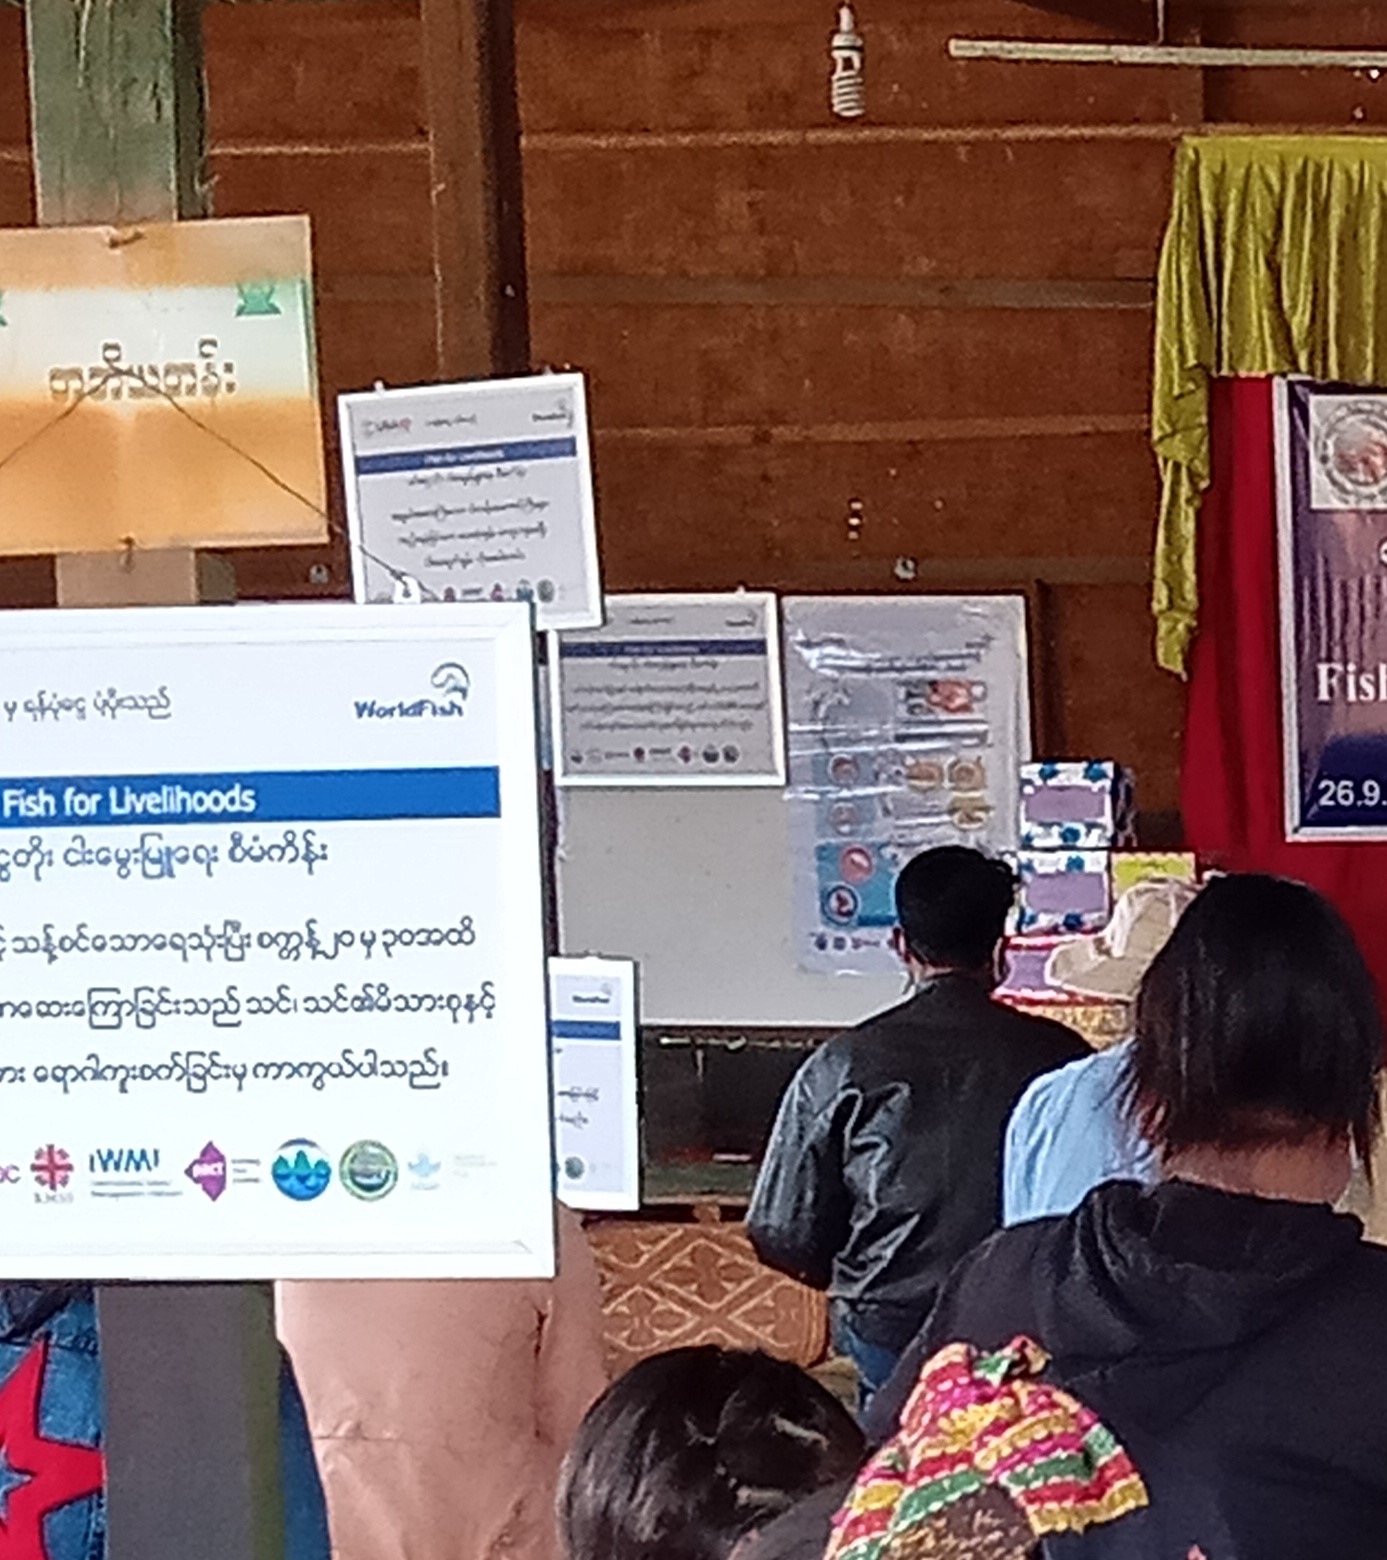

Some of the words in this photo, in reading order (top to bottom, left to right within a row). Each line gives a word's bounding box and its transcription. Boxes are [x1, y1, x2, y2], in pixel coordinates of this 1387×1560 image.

[354, 700, 465, 719] WorldFish
[3, 789, 55, 818] Fish
[63, 787, 102, 816] for
[109, 783, 256, 815] Livelihoods
[228, 830, 328, 875] စီမံကိန်း
